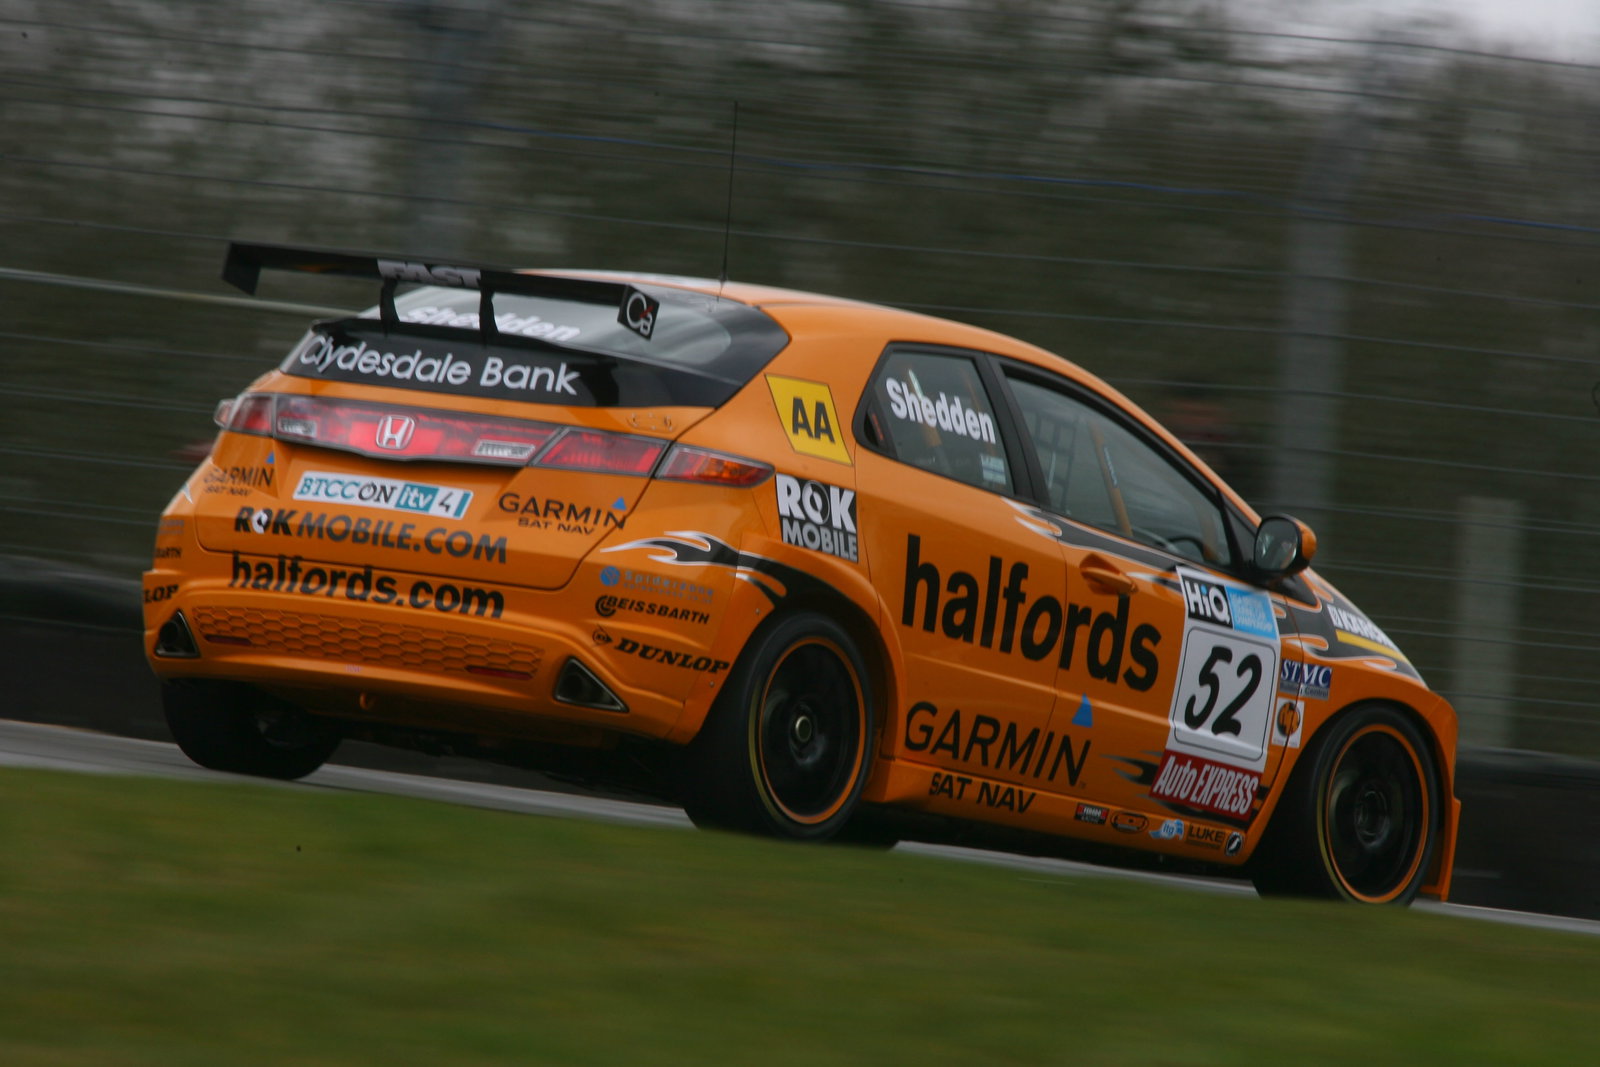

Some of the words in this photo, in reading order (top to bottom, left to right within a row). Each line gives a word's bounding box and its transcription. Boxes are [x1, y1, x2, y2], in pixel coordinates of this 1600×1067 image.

[301, 335, 471, 386] Clydesdale
[480, 357, 580, 395] Bank
[792, 397, 835, 444] AA
[886, 378, 996, 444] Shedden
[499, 493, 627, 530] GARMIN
[518, 517, 553, 530] SAT
[556, 522, 595, 536] NAV
[775, 473, 857, 534] ROK
[782, 517, 858, 564] MOBILE
[229, 550, 505, 619] halfords.com
[1184, 580, 1231, 625] HiQ
[901, 533, 1162, 692] halfords
[614, 637, 730, 674] DUNLOP
[1281, 659, 1332, 688] STMC
[1184, 645, 1262, 738] 52
[904, 701, 1092, 787] GARMIN
[928, 772, 972, 801] SAT
[976, 781, 1036, 814] NAV
[1192, 763, 1259, 816] EXPRESS
[1187, 824, 1225, 844] LUKE
